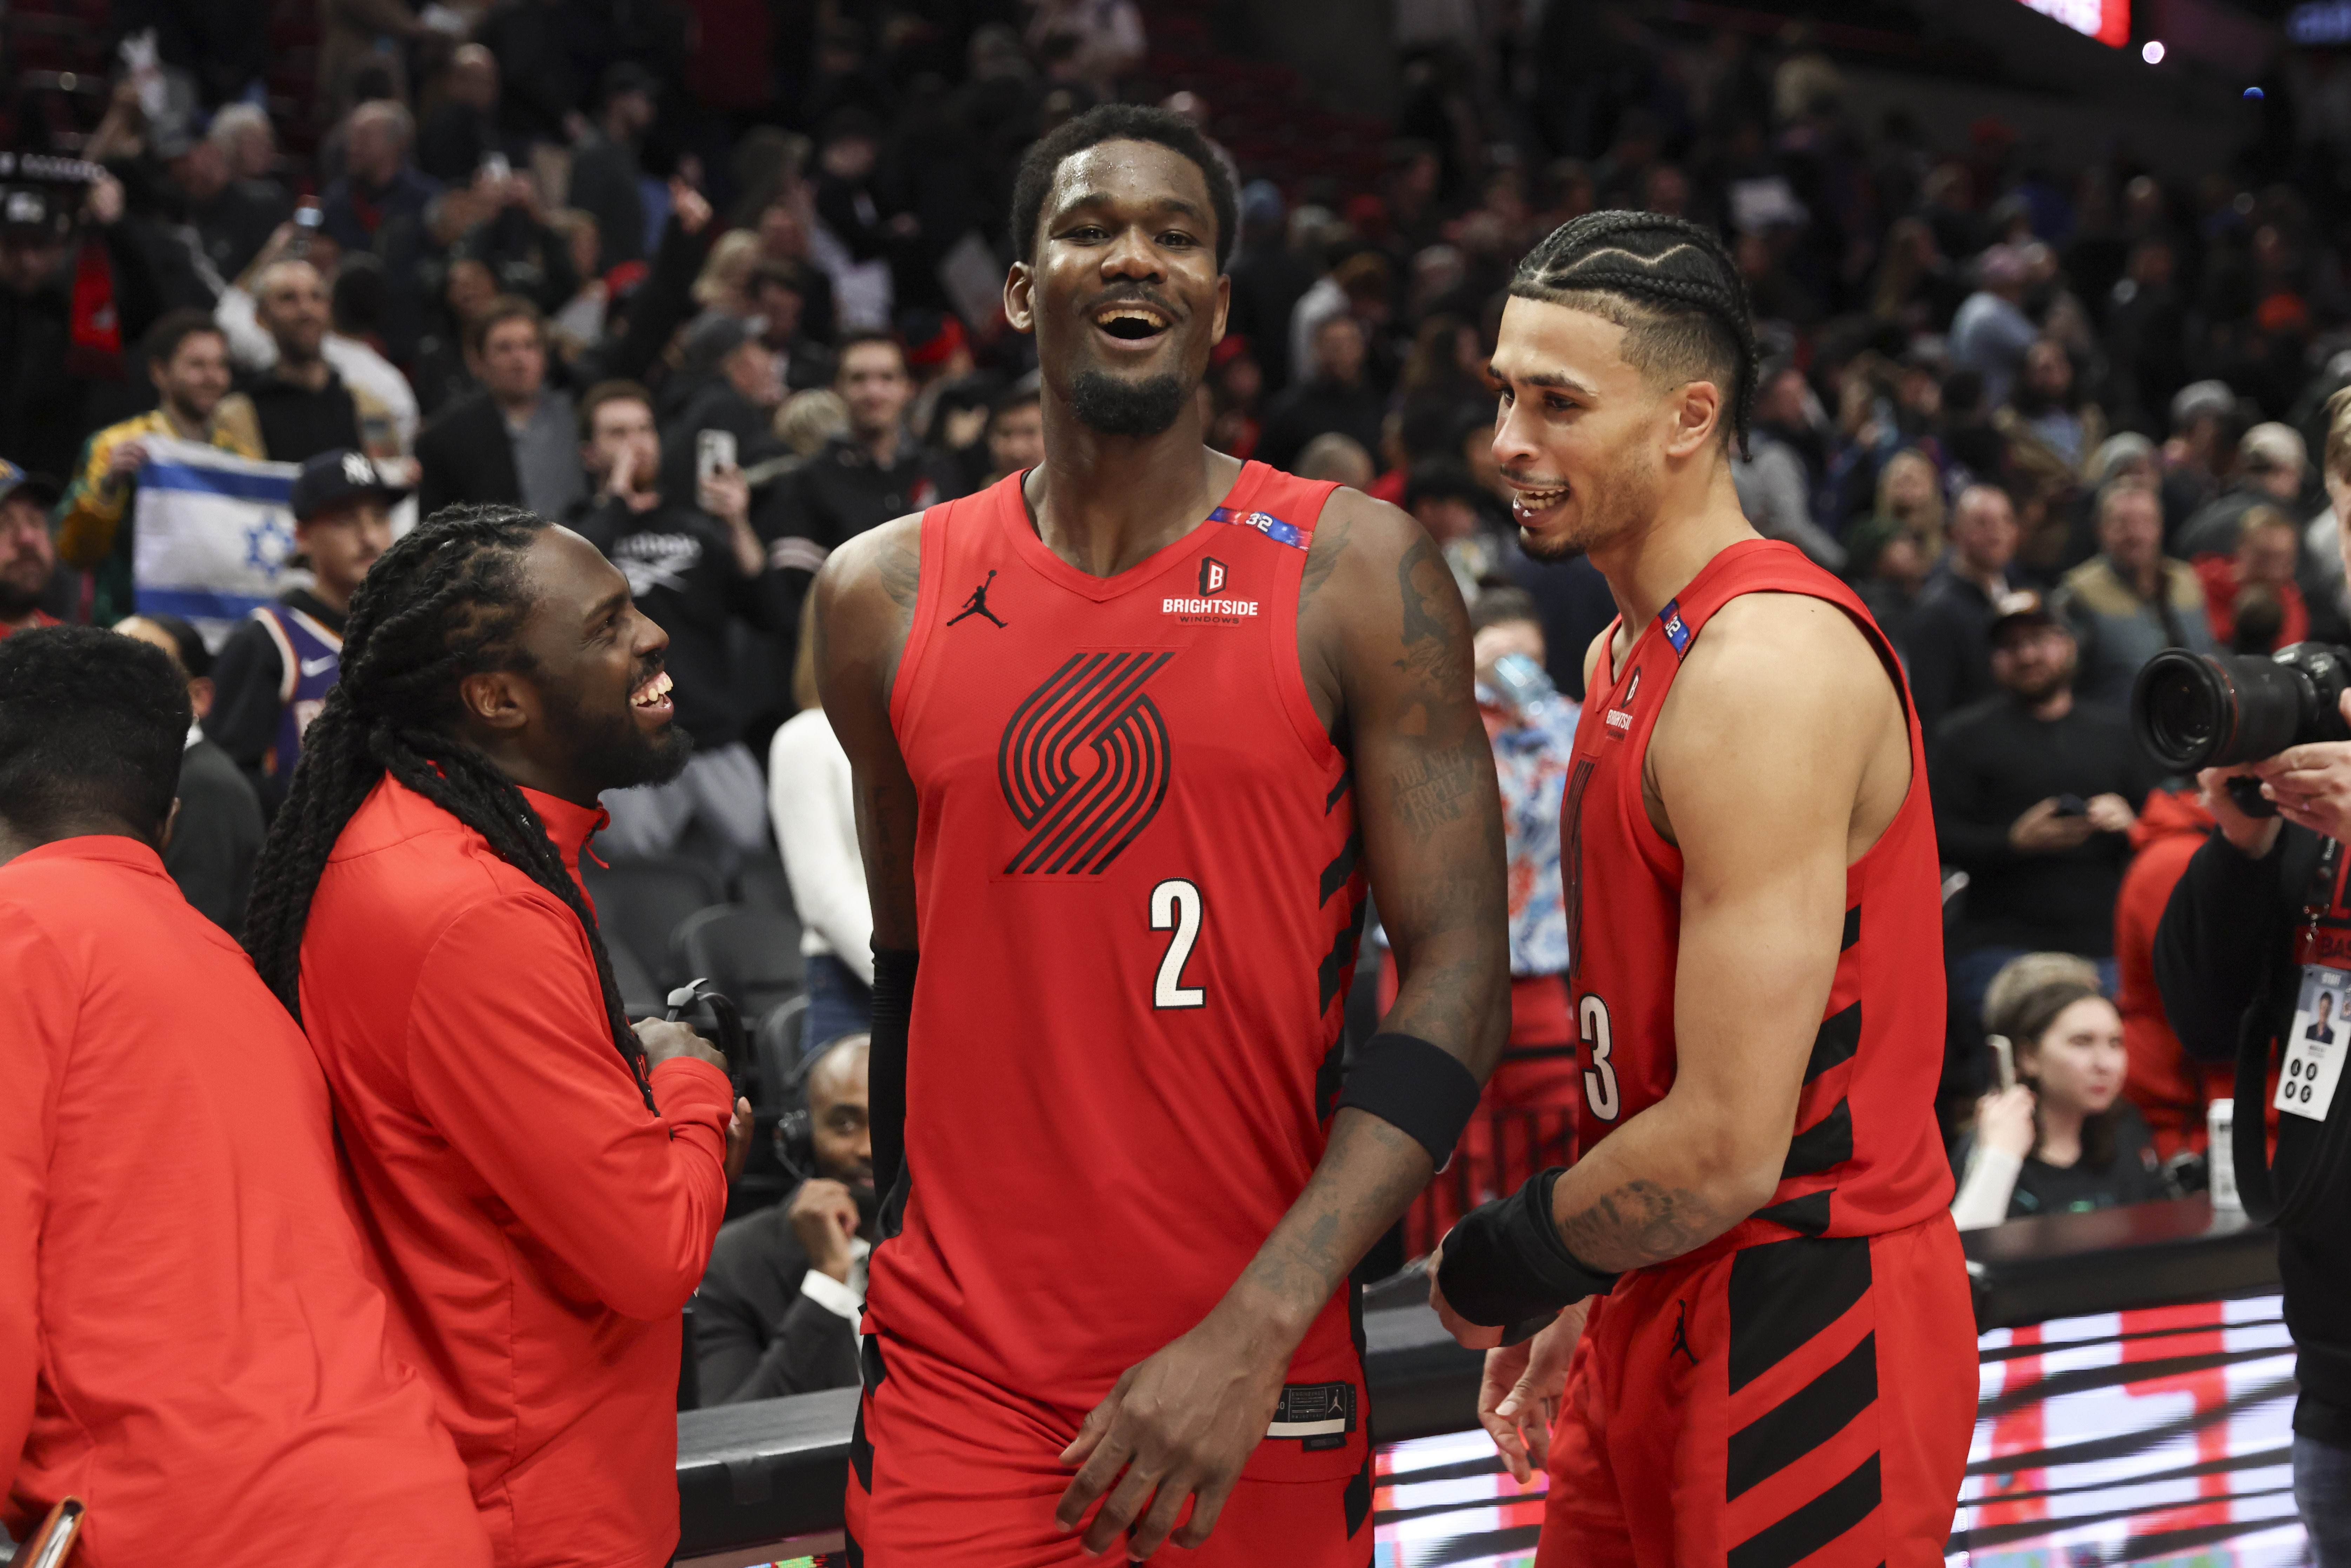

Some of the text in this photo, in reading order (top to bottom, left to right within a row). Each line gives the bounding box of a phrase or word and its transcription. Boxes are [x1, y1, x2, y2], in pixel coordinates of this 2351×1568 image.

[1245, 513, 1273, 533] 32
[1209, 564, 1223, 590] B
[1162, 599, 1259, 616] BRIGHTSIDE
[1665, 615, 1681, 638] 32
[1148, 877, 1206, 1010] 2
[1579, 992, 1621, 1124] 3
